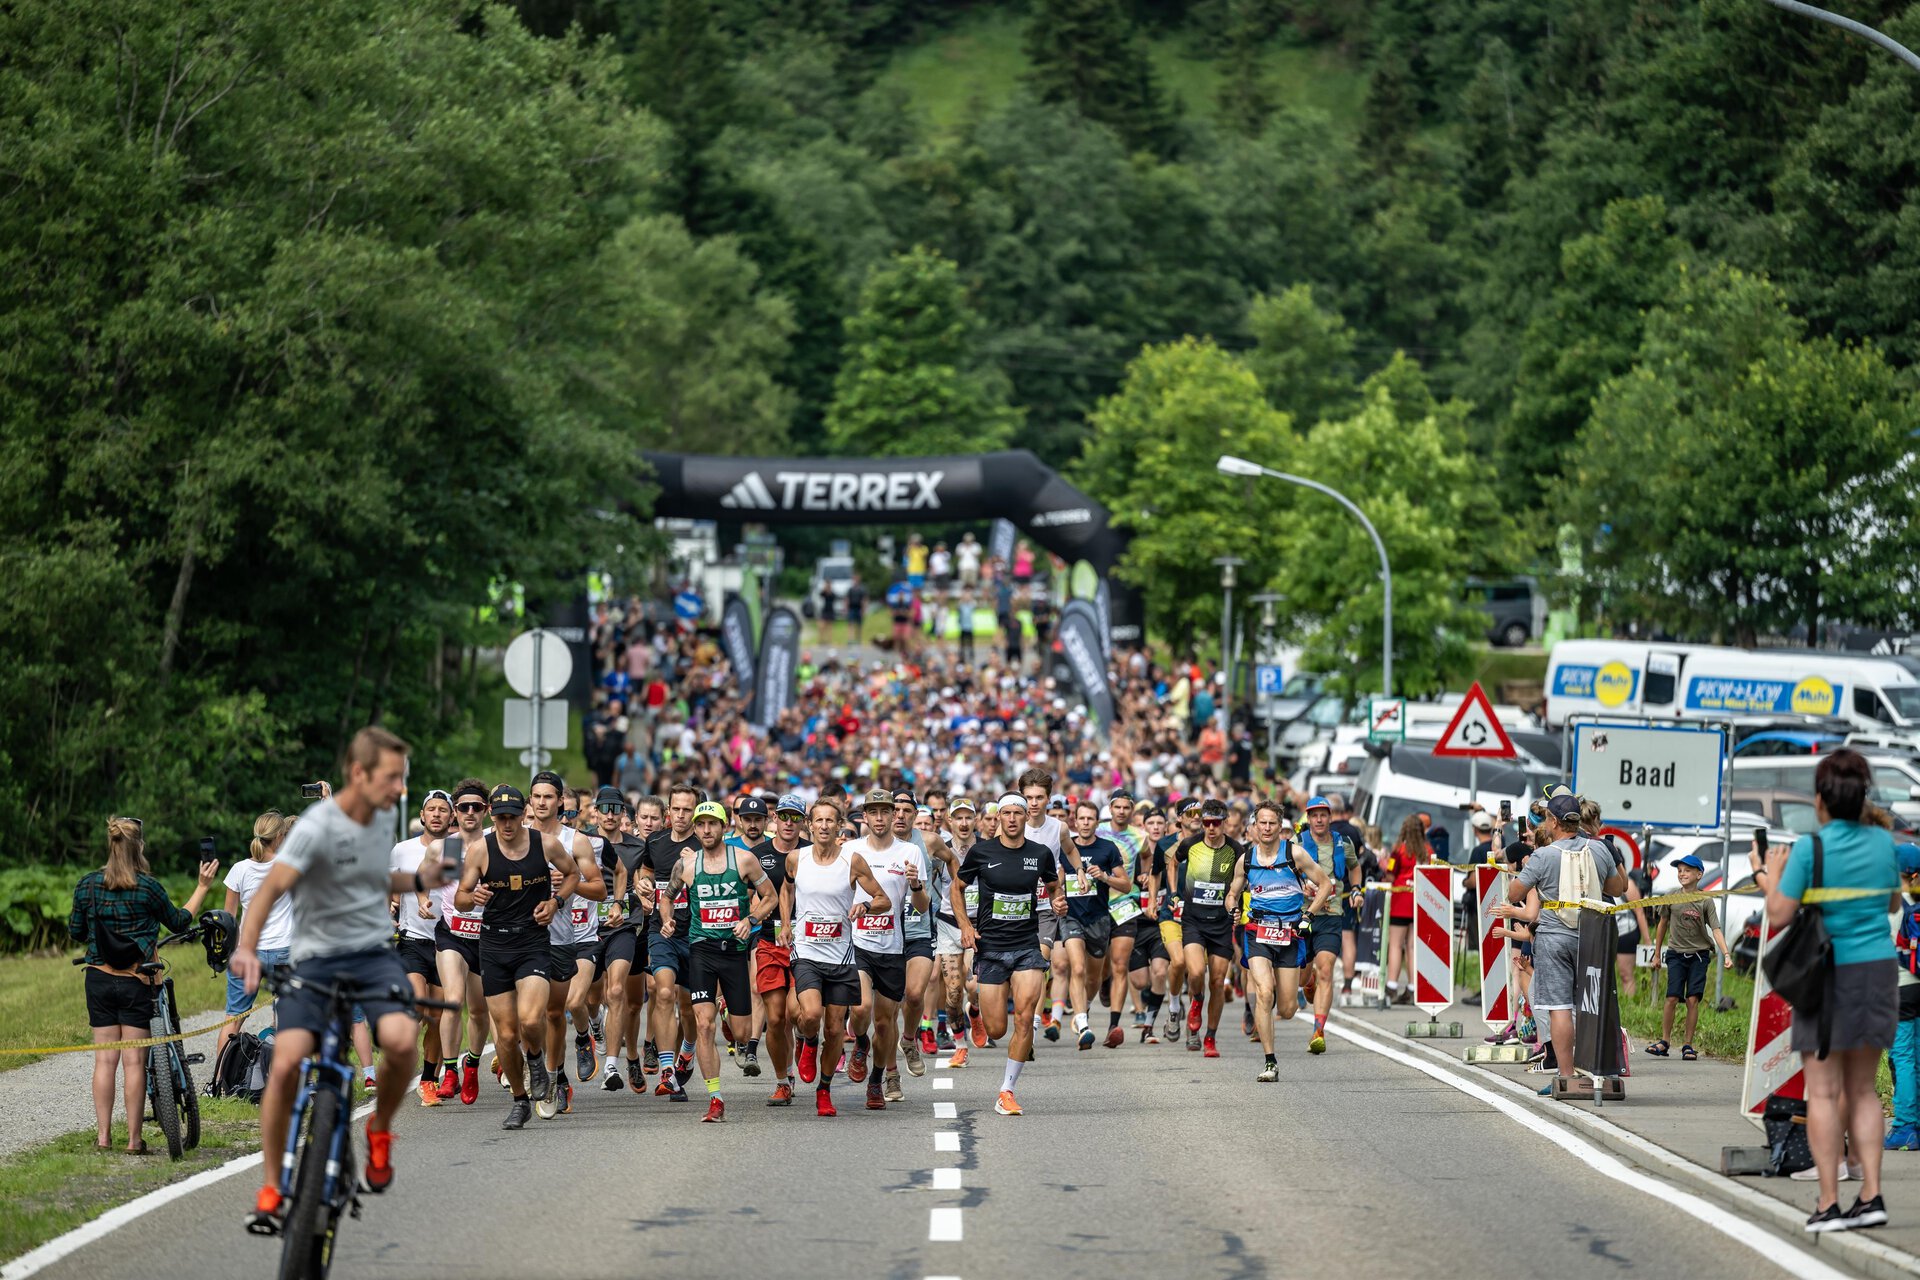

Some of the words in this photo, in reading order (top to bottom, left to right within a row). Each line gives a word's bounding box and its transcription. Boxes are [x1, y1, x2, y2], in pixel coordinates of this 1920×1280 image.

[776, 470, 945, 510] TERREX
[1619, 759, 1676, 788] Baad
[697, 881, 737, 898] BIX
[1202, 889, 1216, 898] 20
[1001, 902, 1025, 912] 384
[708, 908, 733, 920] 1140
[863, 916, 889, 927] 1240
[811, 923, 838, 934] 1287
[1264, 927, 1285, 938] 1126
[691, 990, 709, 1001] BIX
